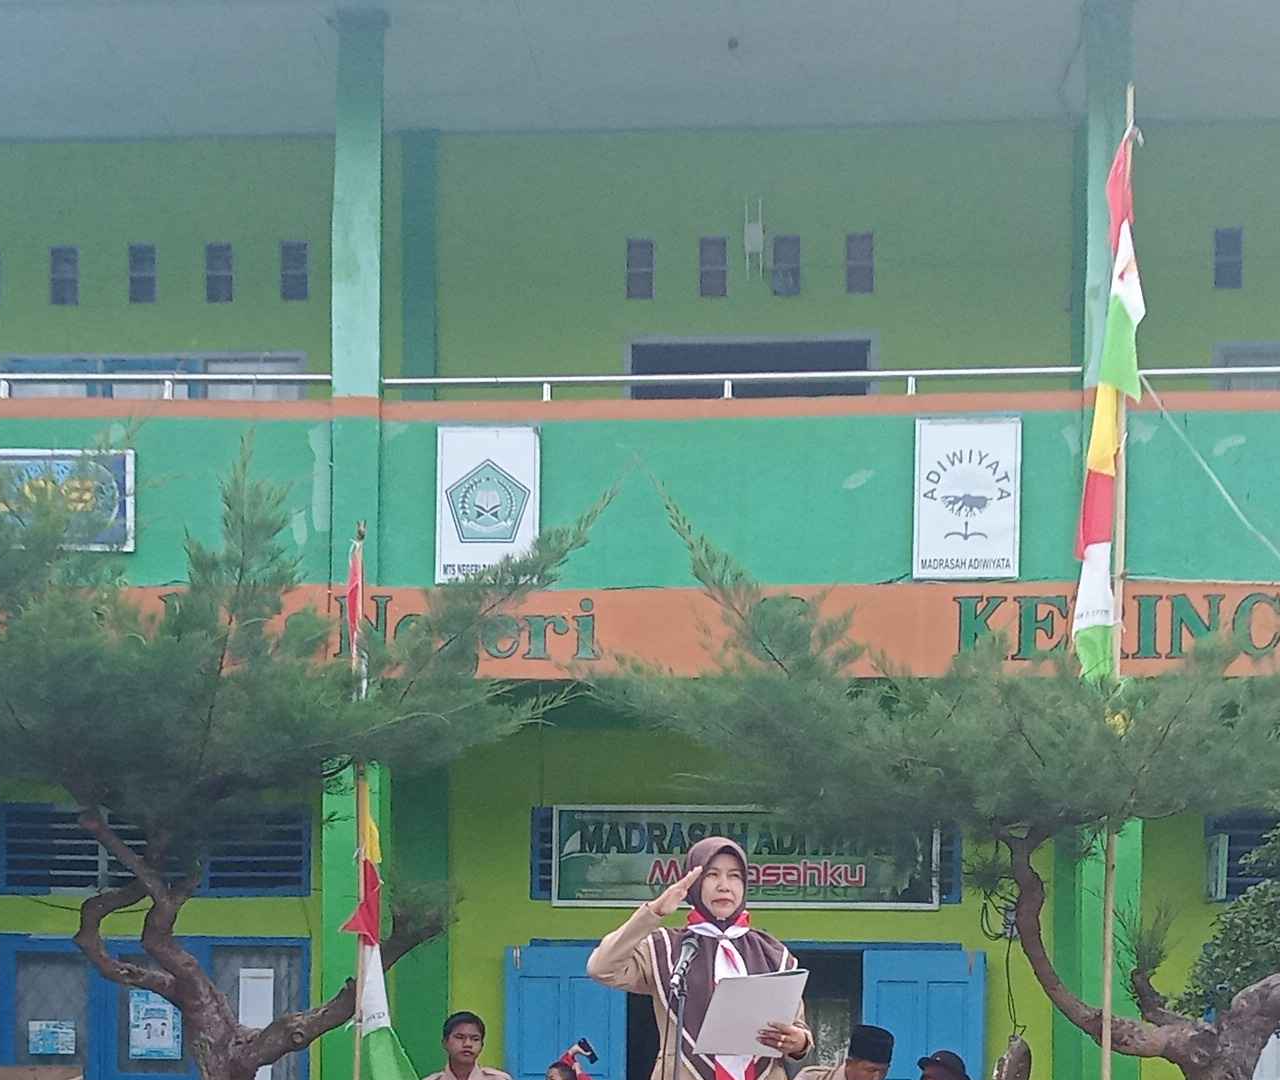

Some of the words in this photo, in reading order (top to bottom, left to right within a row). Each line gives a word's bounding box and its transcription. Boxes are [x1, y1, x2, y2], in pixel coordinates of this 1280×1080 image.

[923, 449, 1012, 501] ADIWIYATA
[921, 558, 967, 570] MADRASAH
[968, 558, 1011, 570] ADIWIYATA
[333, 595, 602, 672] Neri
[648, 858, 865, 888] Masahku
